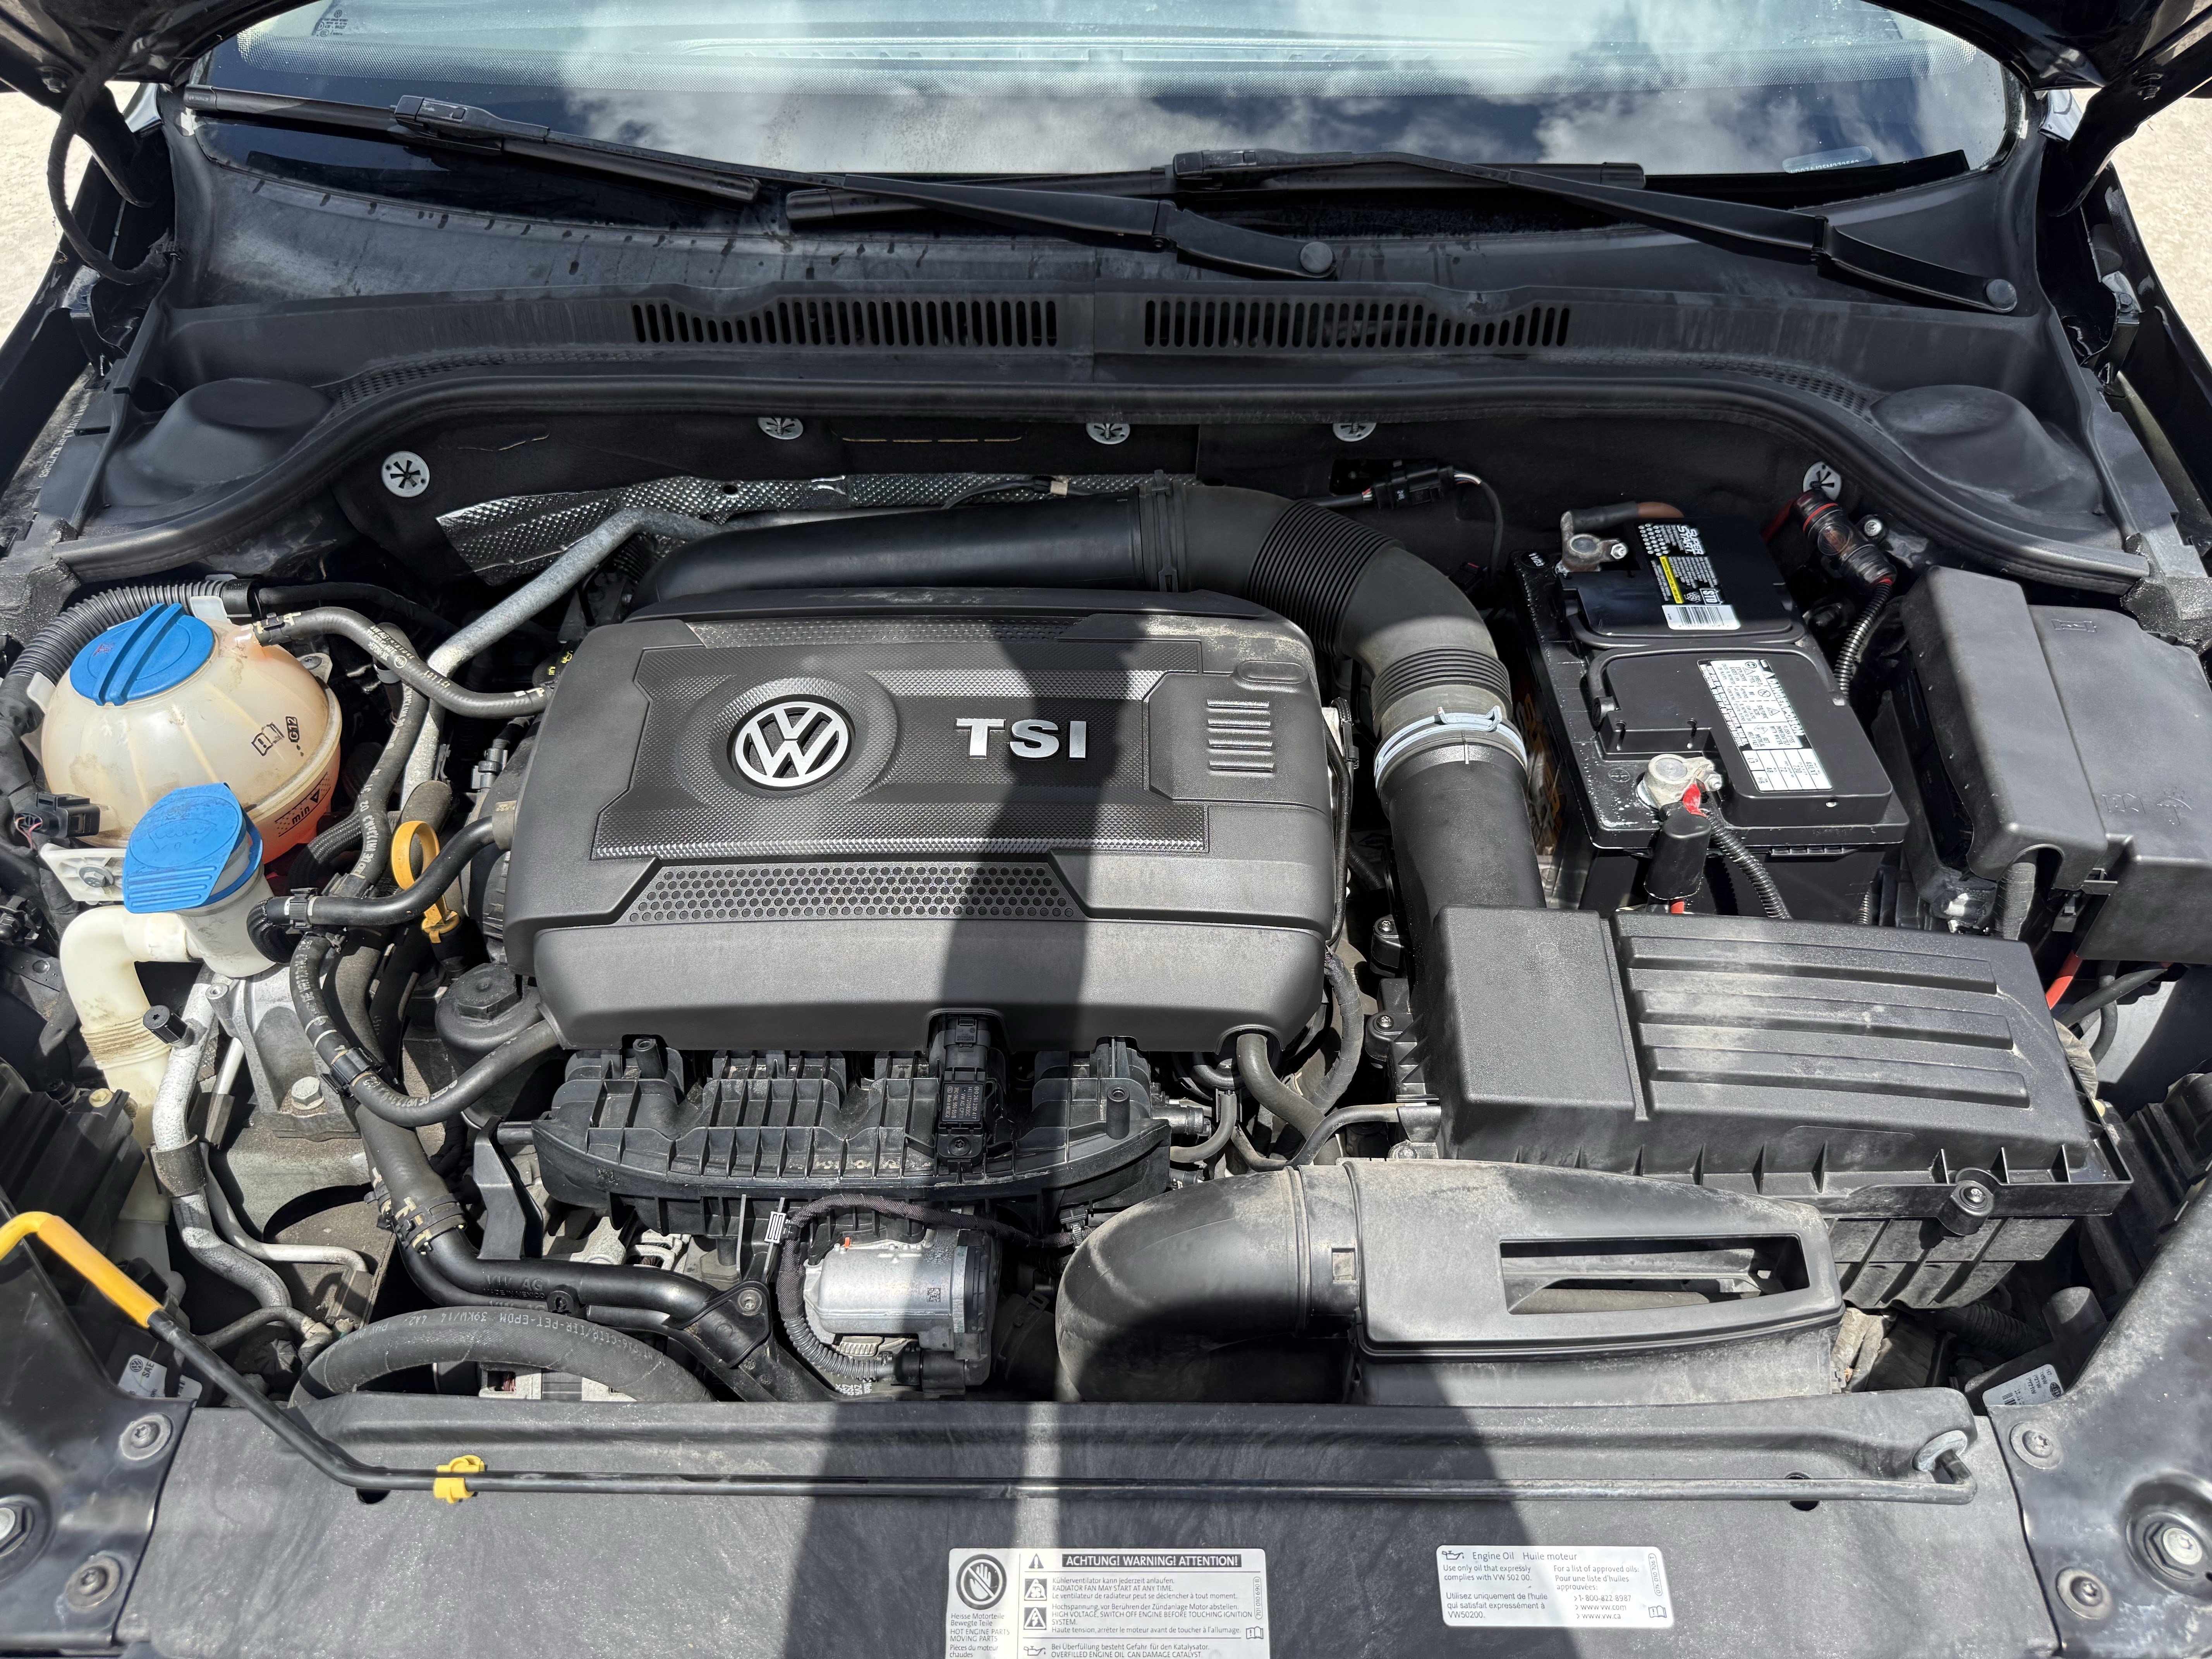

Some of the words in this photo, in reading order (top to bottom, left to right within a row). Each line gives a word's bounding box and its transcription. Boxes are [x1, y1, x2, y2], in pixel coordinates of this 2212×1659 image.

[1677, 525, 1695, 553] START
[1689, 529, 1704, 555] SUPER
[1702, 590, 1718, 603] STD
[287, 718, 299, 740] G12
[955, 718, 1087, 761] TSI
[1792, 765, 1802, 773] 730
[291, 805, 310, 825] min
[521, 1278, 543, 1291] AG
[142, 1362, 155, 1378] SAE
[1066, 1556, 1120, 1566] ACHTUNG!
[1123, 1556, 1176, 1566] WARNING!
[1178, 1556, 1238, 1566] ATTENTION!
[1473, 1552, 1501, 1562] Engine
[1503, 1552, 1514, 1560] Oil
[1523, 1552, 1544, 1560] Huile
[1458, 1565, 1472, 1573] only
[1500, 1565, 1531, 1573] expressly
[1593, 1565, 1624, 1574] approved
[1119, 1577, 1145, 1585] jederzeit
[1444, 1574, 1475, 1582] complies
[1557, 1583, 1598, 1592] approuvées:
[1474, 1592, 1515, 1601] uniquement
[1447, 1602, 1458, 1611] qui
[1489, 1602, 1539, 1610] expressément
[1208, 1626, 1241, 1635] l'allumage.
